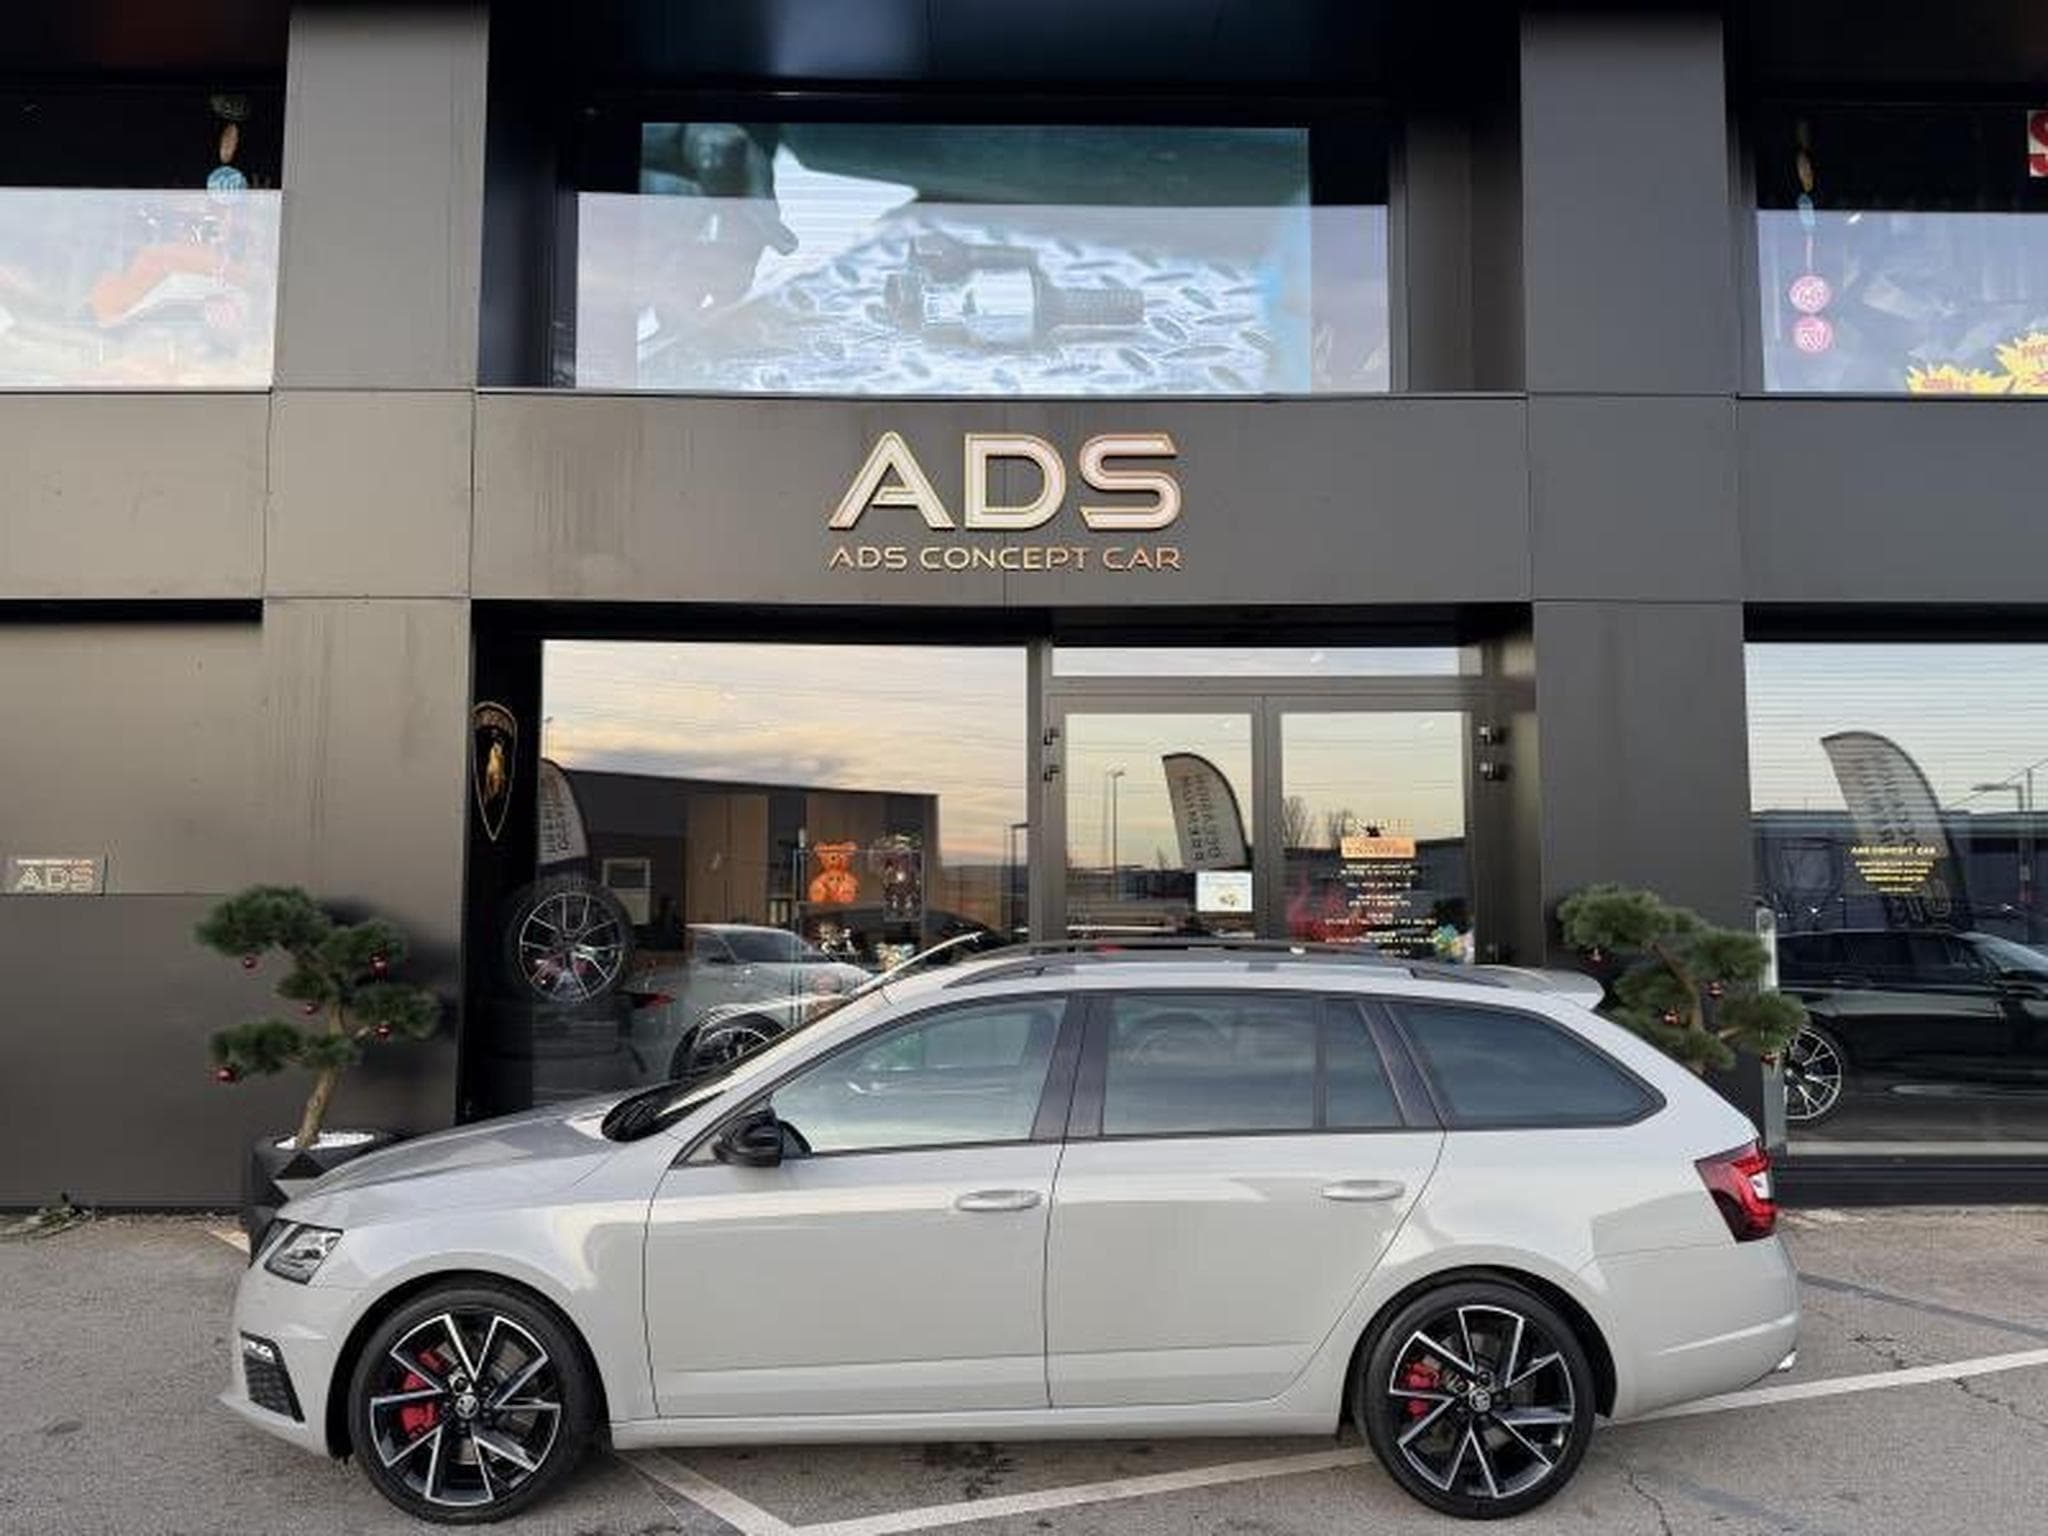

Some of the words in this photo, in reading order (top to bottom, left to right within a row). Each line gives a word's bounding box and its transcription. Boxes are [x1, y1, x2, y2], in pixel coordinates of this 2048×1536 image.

[829, 431, 1182, 530] ADS
[829, 547, 907, 571] ADS
[920, 547, 1089, 571] CONCEPT
[1102, 547, 1181, 571] CAR
[17, 866, 94, 892] ADS
